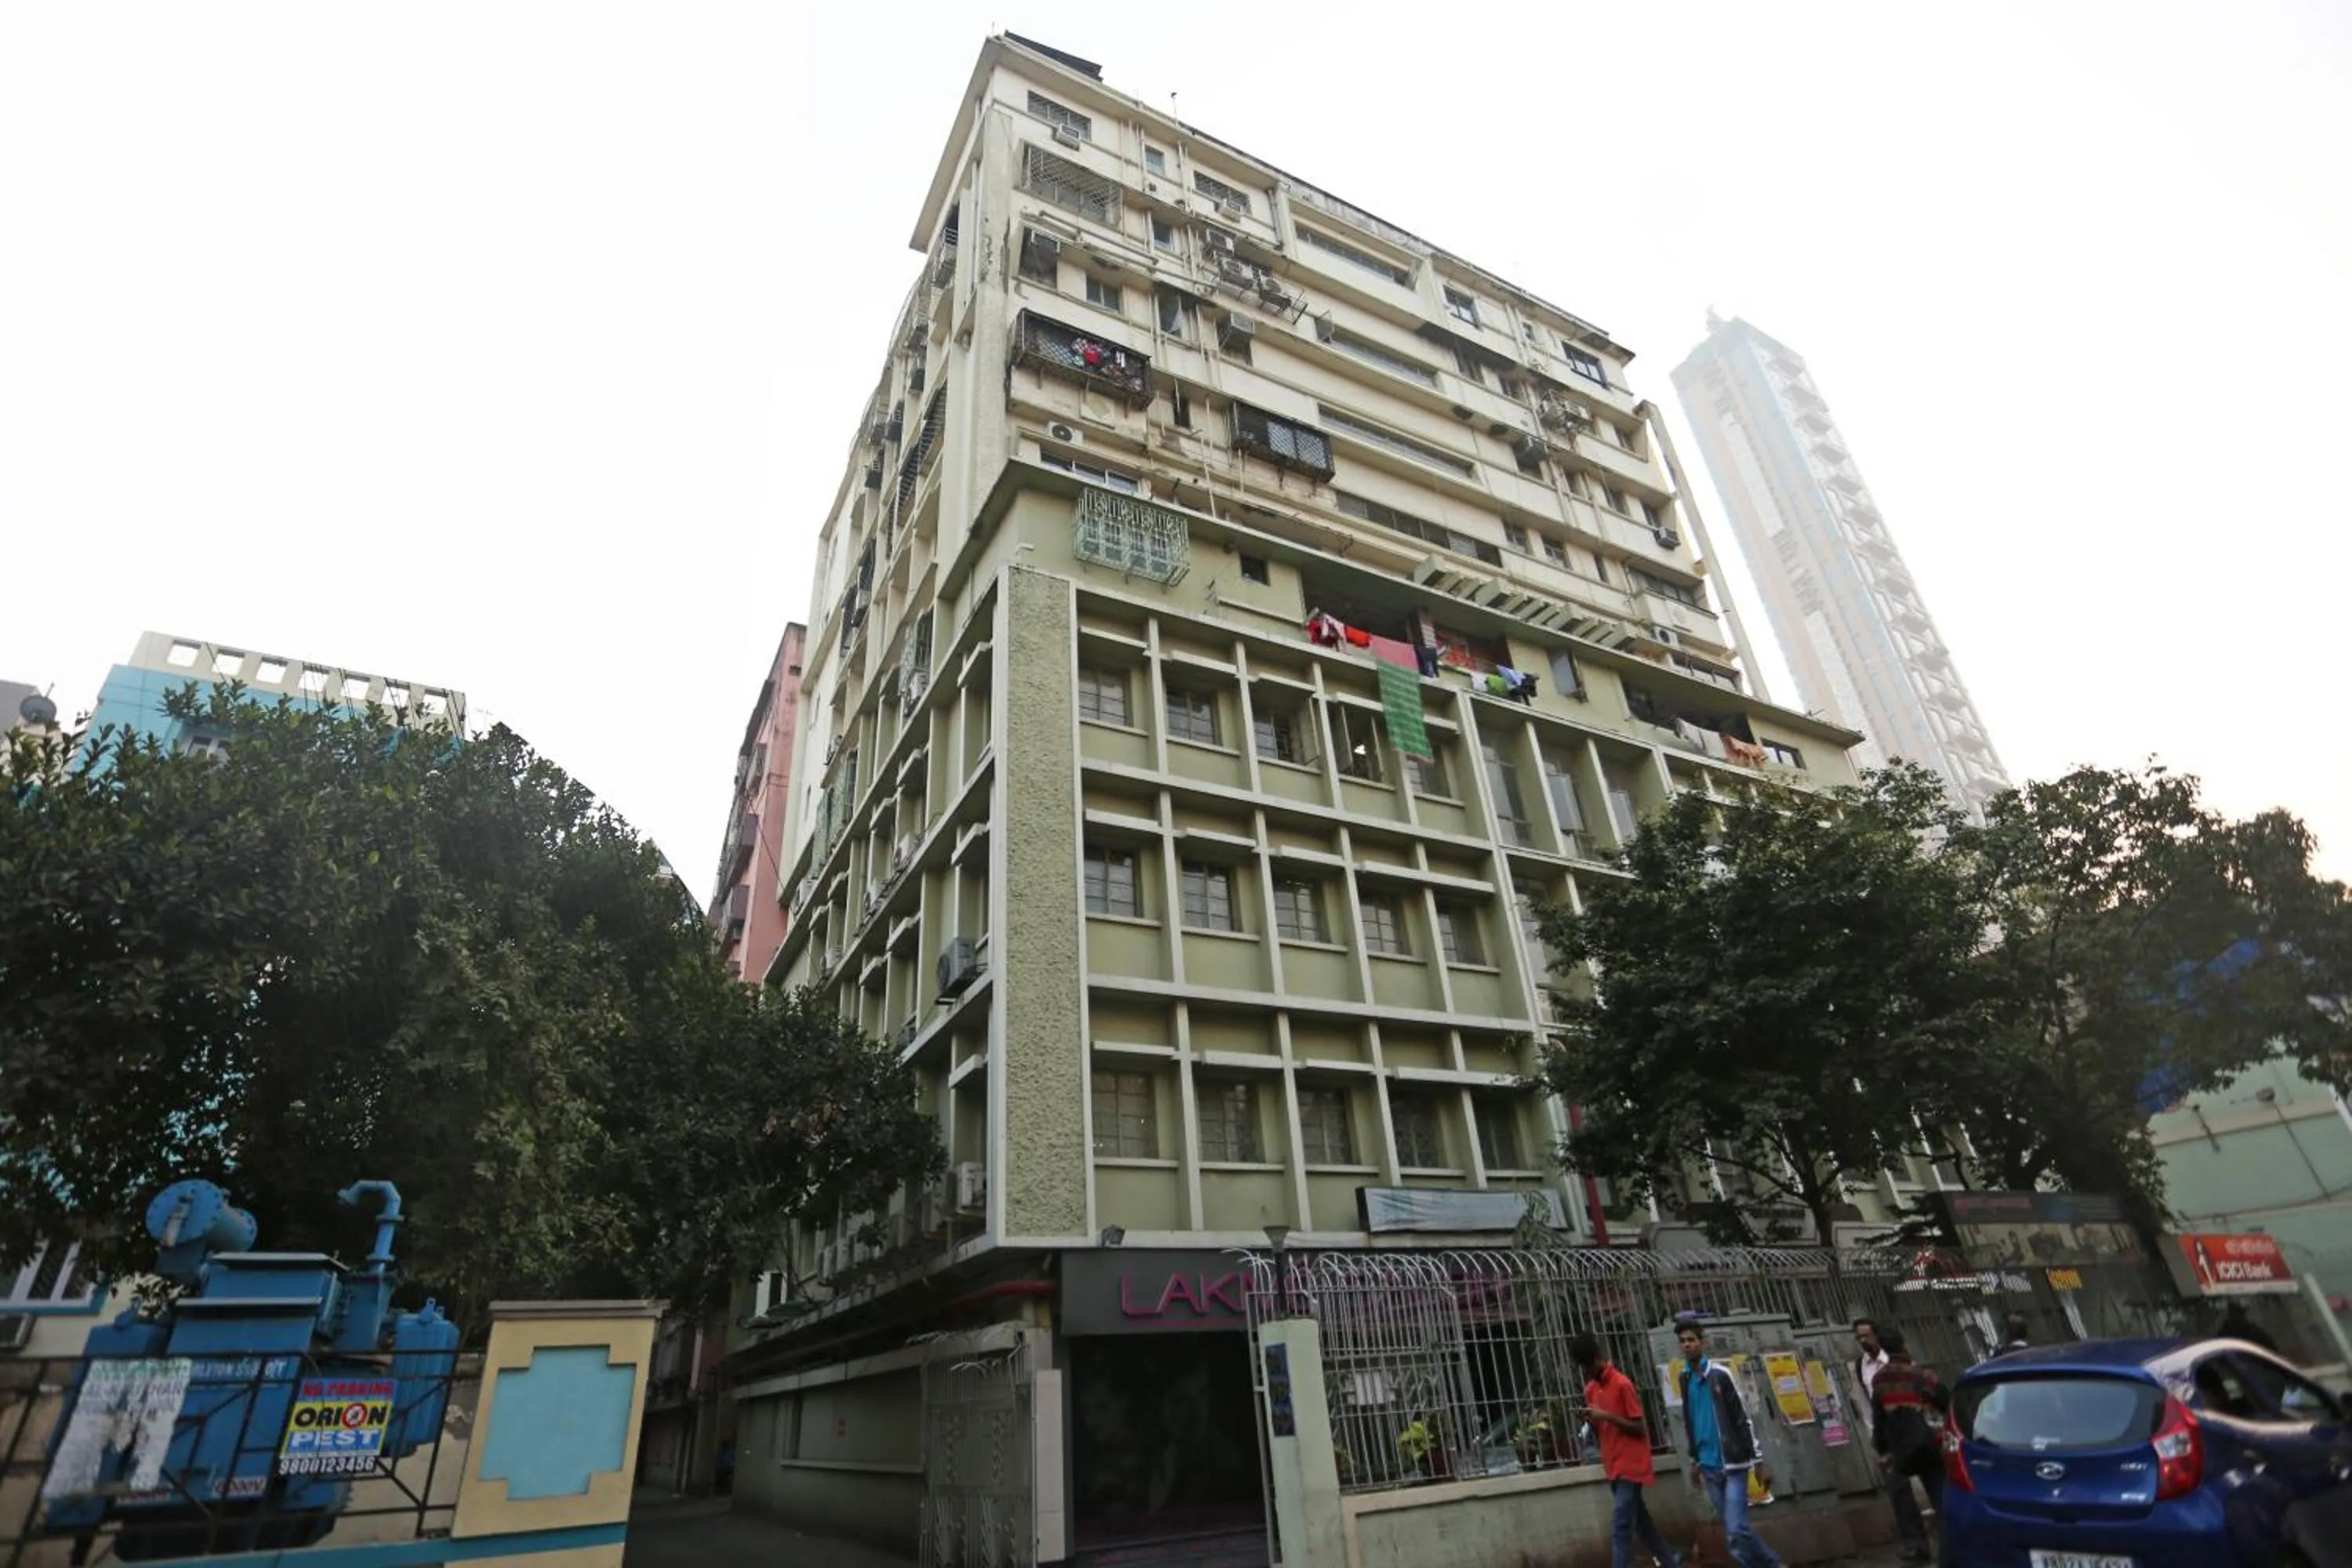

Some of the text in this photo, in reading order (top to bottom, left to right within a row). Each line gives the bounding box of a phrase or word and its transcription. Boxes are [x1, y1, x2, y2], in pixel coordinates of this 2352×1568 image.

[294, 1402, 387, 1428] ORION
[290, 1429, 379, 1448] PEST
[278, 1456, 376, 1475] 9800123456
